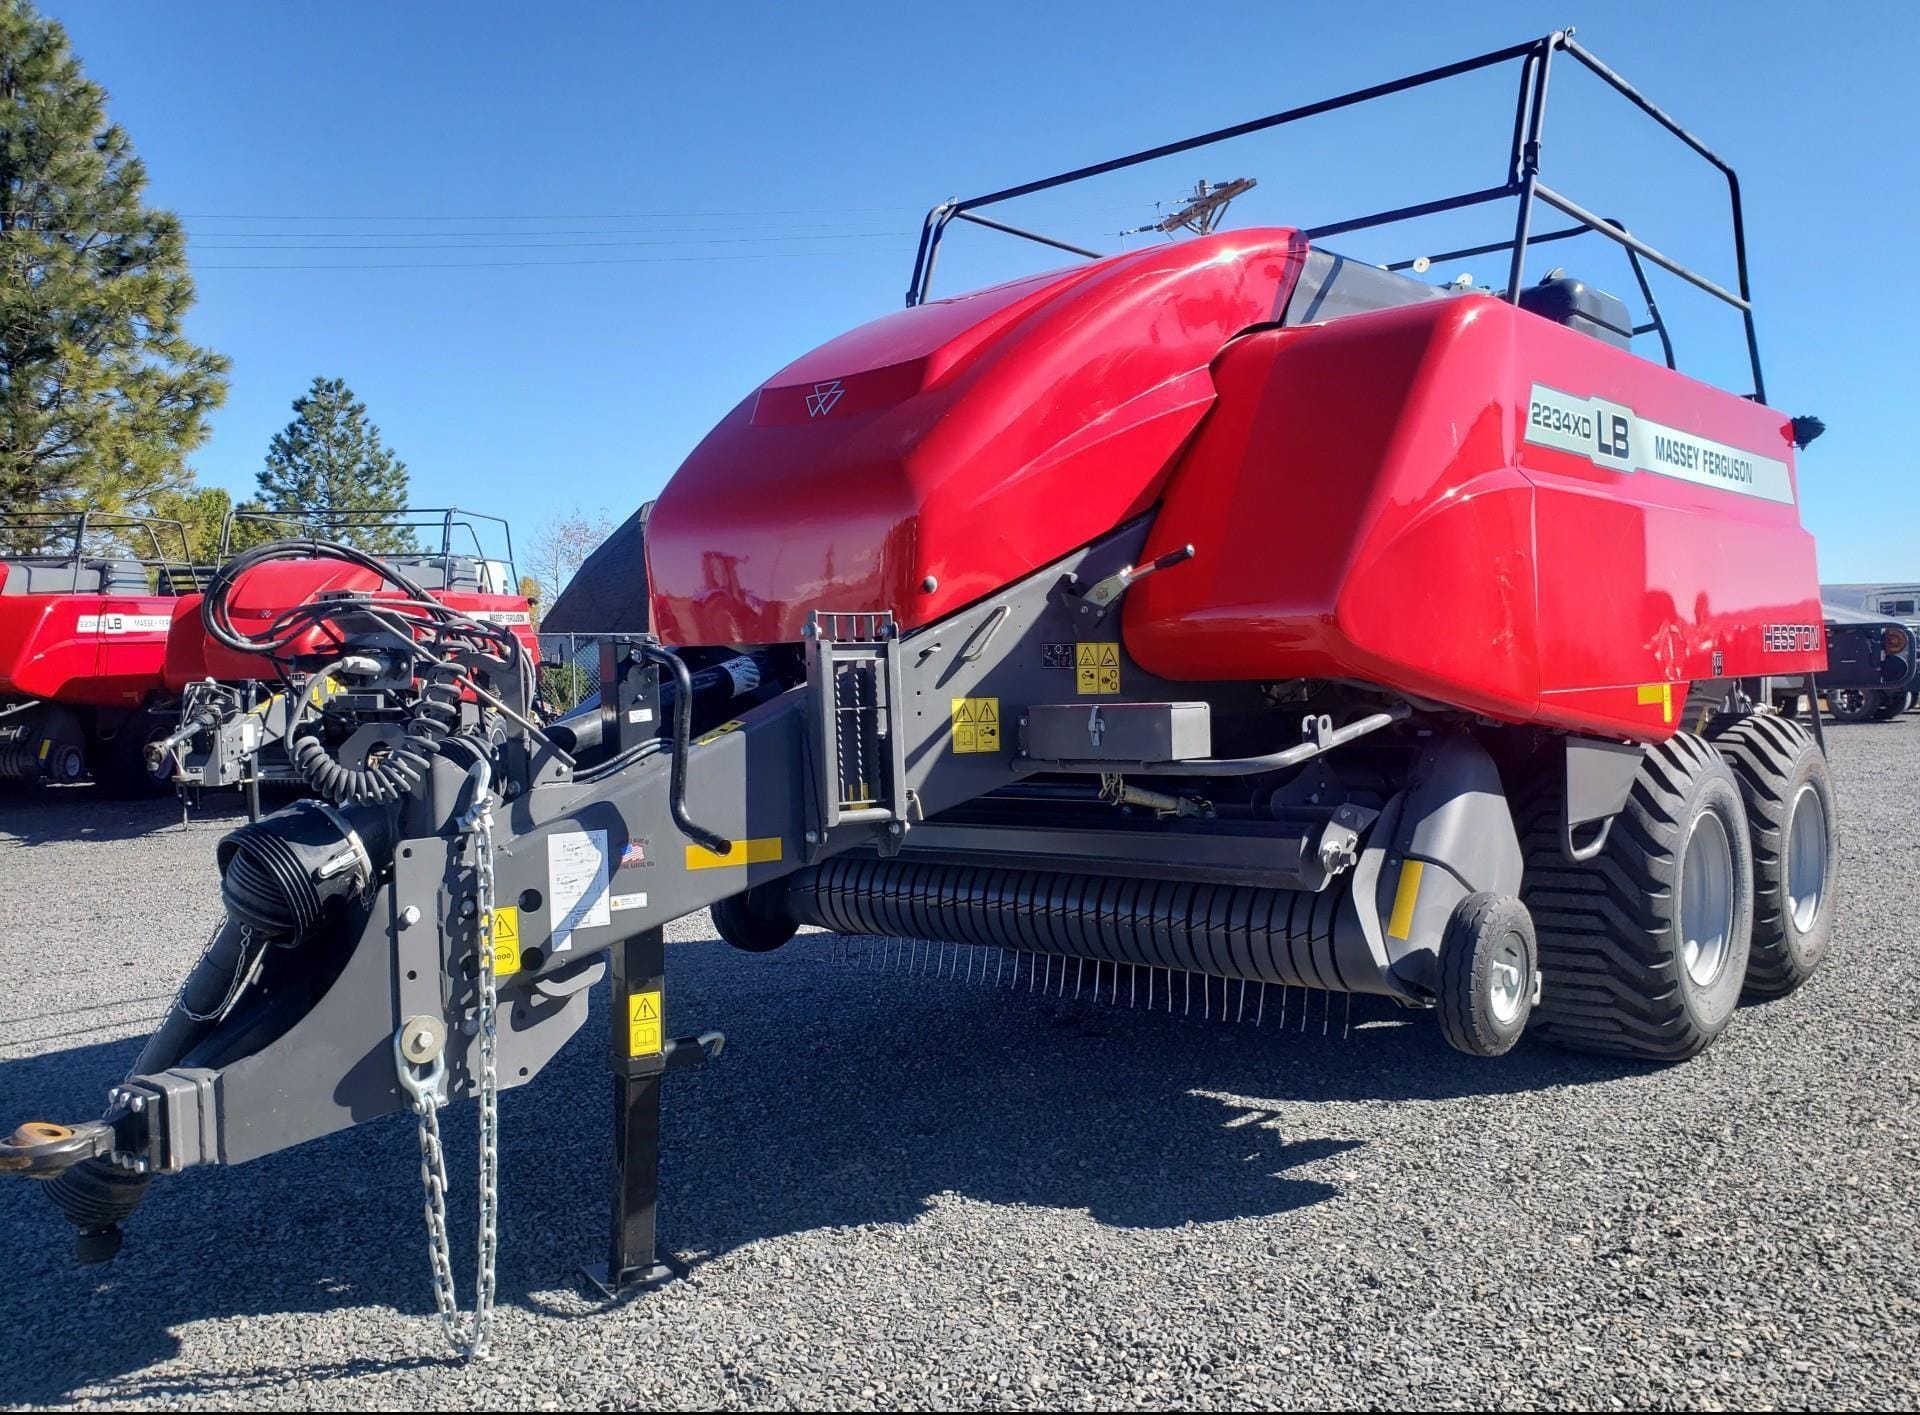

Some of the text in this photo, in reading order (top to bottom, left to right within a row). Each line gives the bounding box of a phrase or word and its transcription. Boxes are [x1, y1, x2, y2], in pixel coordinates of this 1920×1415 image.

[1532, 402, 1630, 460] 2234XD LB
[1655, 435, 1753, 484] MASSEY FERGUSON
[107, 617, 122, 630] LB
[1762, 624, 1820, 652] HESSTON
